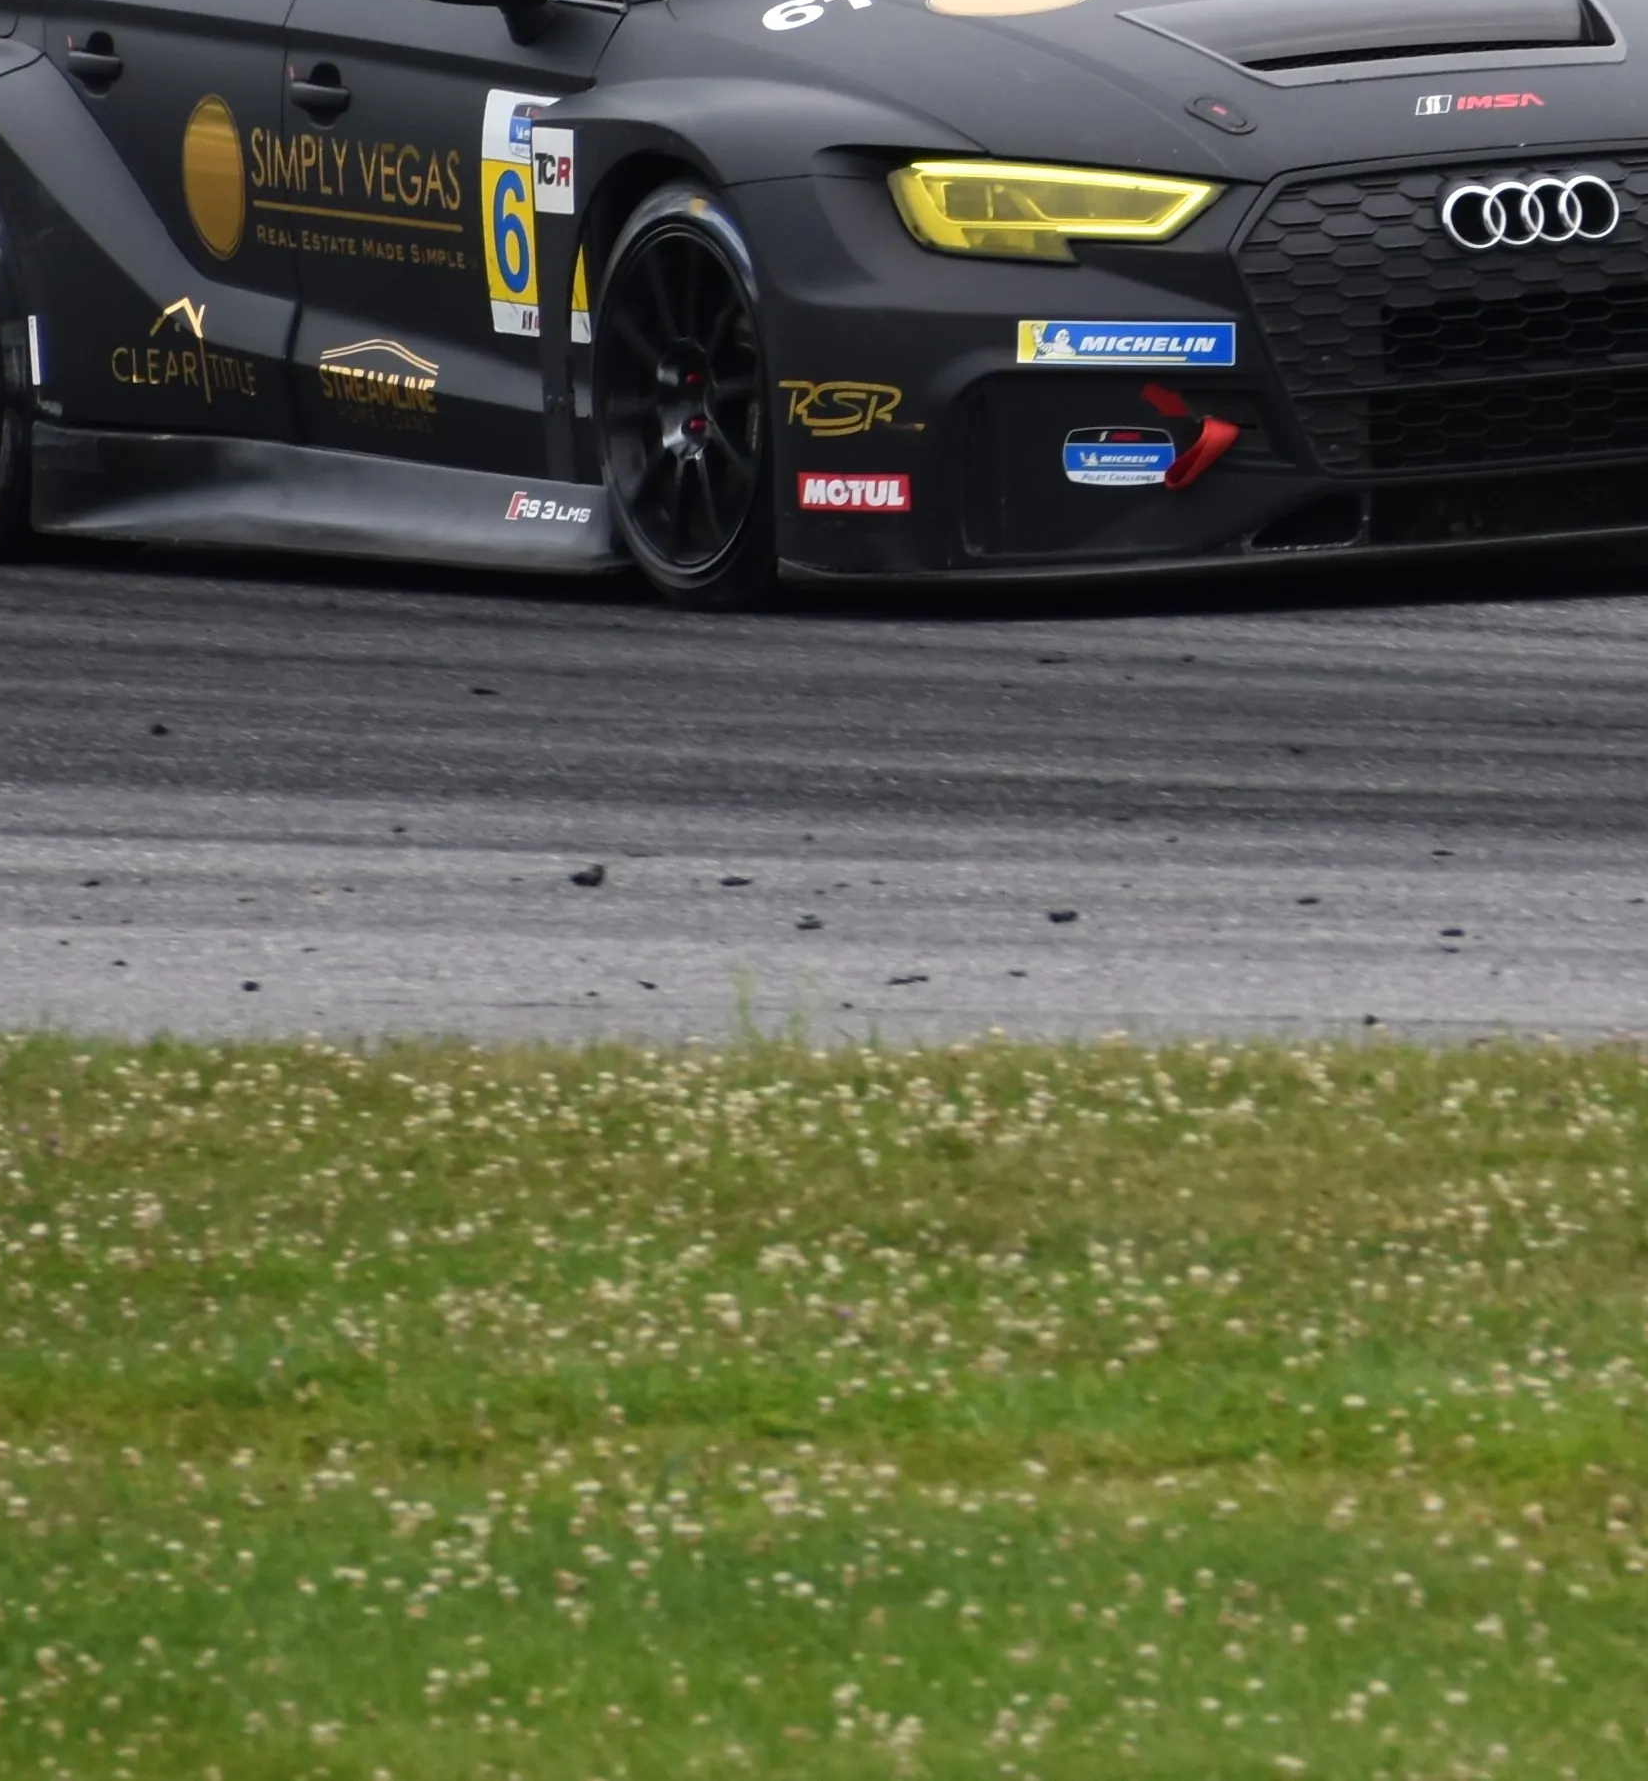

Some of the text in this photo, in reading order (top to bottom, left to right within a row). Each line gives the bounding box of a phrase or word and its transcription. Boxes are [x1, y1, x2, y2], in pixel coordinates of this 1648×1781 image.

[1456, 92, 1546, 112] IMSA
[251, 126, 462, 212] SIMPLY VEGAS
[534, 152, 572, 188] TCR
[256, 223, 467, 270] REAL ESTATE MADE SIMPLE
[1078, 335, 1218, 353] MICHELIN
[111, 346, 257, 397] CLEAR TITLE
[319, 363, 439, 414] STREAMLINE
[1099, 454, 1161, 464] MICHELIN
[803, 478, 905, 507] MOTUL
[514, 498, 592, 523] RS 3 LMS
